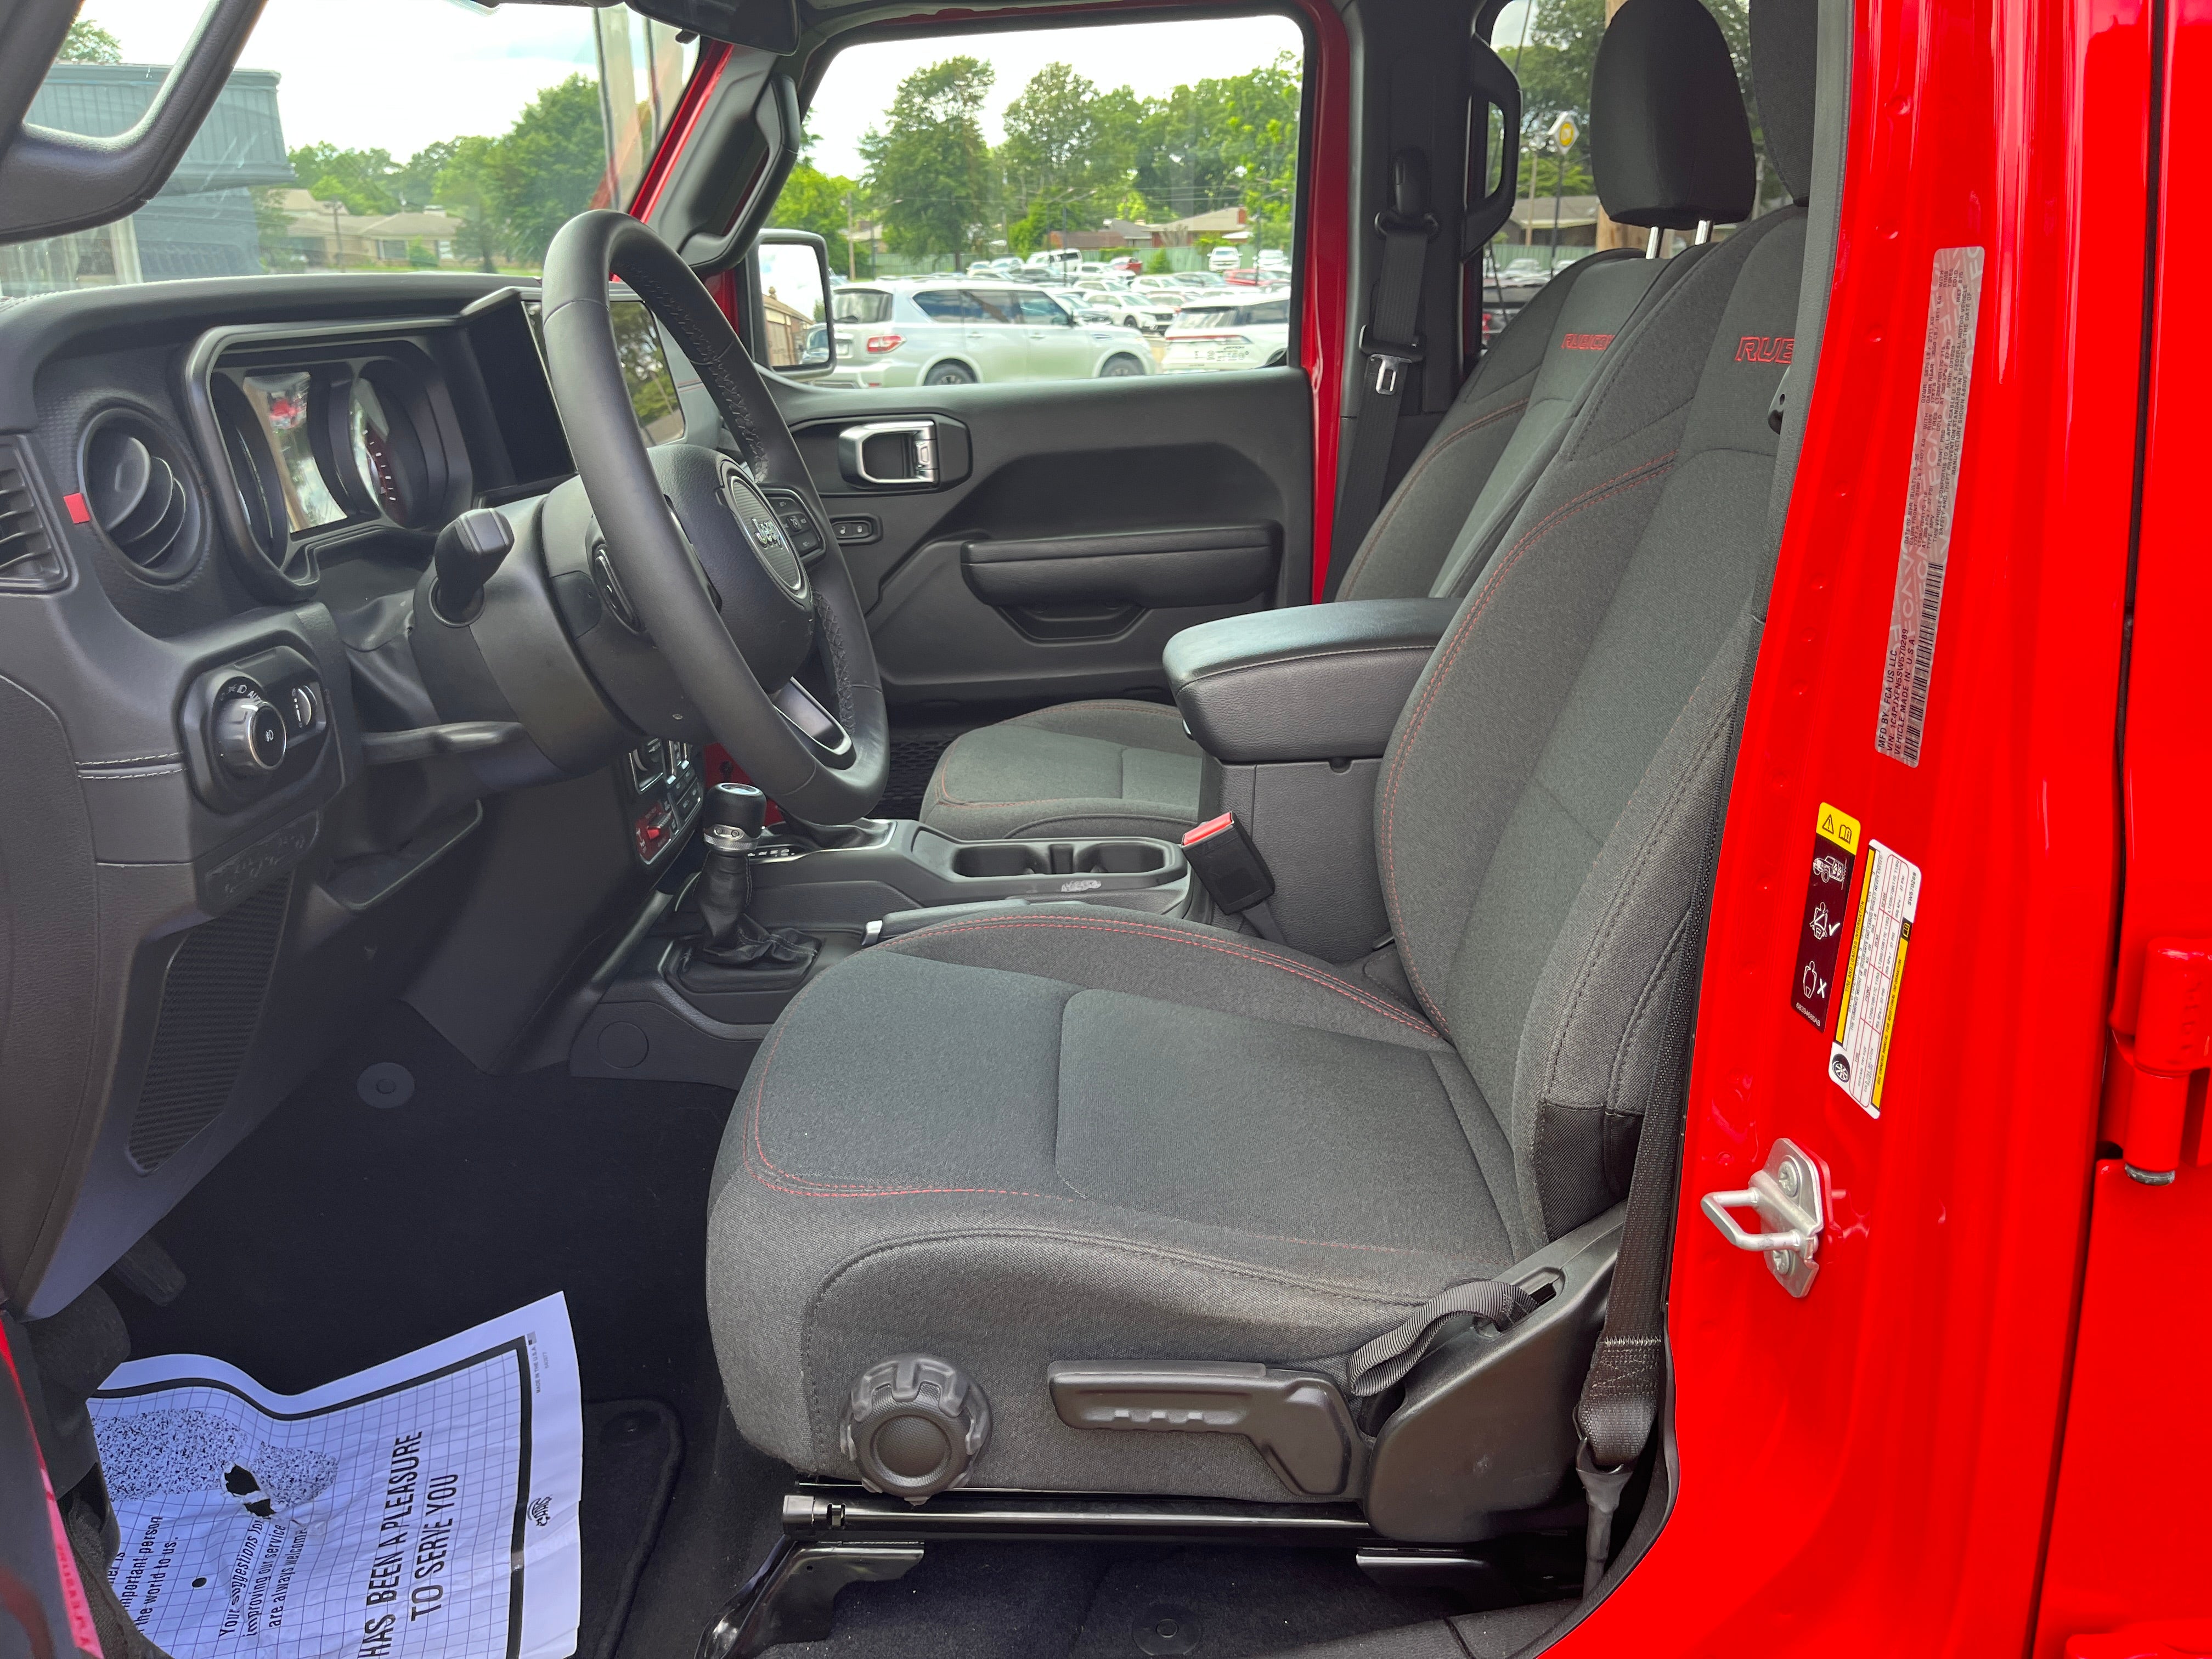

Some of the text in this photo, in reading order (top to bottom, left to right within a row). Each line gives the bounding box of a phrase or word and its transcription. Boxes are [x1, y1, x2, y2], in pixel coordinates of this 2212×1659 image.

[1938, 462, 1946, 498] CONFORMS
[1946, 396, 1955, 436] APPLICABLE
[1954, 340, 1962, 370] FEDERAL
[1946, 429, 1956, 470] PREVENTION
[1952, 386, 1961, 427] STANDARDS
[1951, 426, 1961, 475] MANUFACTURE
[751, 517, 783, 550] Jeep
[1886, 669, 1894, 683] US
[1888, 648, 1897, 667] LLC
[1883, 685, 1892, 704] FCA
[1887, 628, 1908, 752] VIN: 1C4PJXFN5SW570289
[1878, 726, 1887, 749] MFD
[1894, 715, 1905, 756] VEHICLE
[1900, 684, 1909, 713] MADE
[1849, 939, 1858, 966] LOADING
[1854, 899, 1864, 940] INFORMATION
[120, 1516, 163, 1611] mportant person
[154, 1558, 171, 1570] to
[162, 1537, 178, 1555] us.
[357, 1431, 422, 1659] HAS BEEN A PLEASURE
[411, 1474, 458, 1622] TO SERVE YOU
[143, 1572, 166, 1605] world
[219, 1609, 240, 1637] Your
[231, 1535, 258, 1606] suggestions
[242, 1524, 286, 1637] improving our service
[271, 1566, 296, 1603] always
[269, 1606, 284, 1628] are
